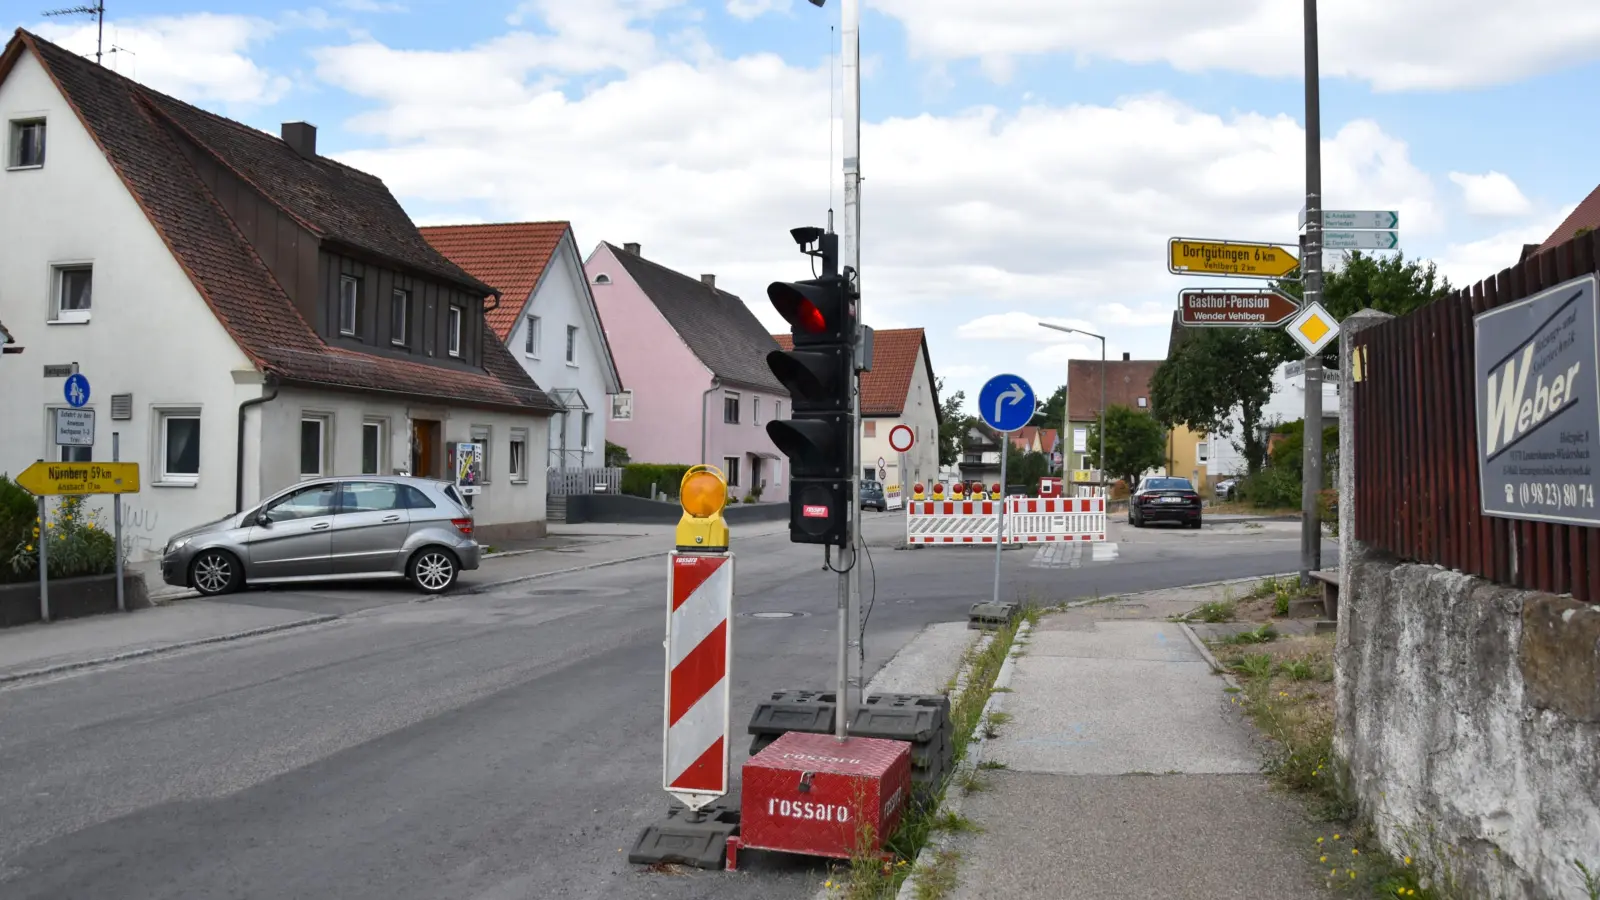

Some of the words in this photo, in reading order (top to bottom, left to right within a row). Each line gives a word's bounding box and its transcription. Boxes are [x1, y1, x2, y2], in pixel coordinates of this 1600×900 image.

[1183, 245, 1249, 263] Dorfgütingen
[1254, 248, 1260, 261] 6
[1262, 251, 1275, 262] km
[1204, 261, 1238, 273] Vehlberg
[1241, 263, 1246, 271] 2
[1189, 295, 1270, 309] Gasthof-Pension
[1194, 312, 1226, 320] Wender
[1228, 312, 1265, 321] Vehlberg
[1486, 341, 1580, 457] Weber
[48, 466, 88, 482] Nürnberg
[91, 466, 100, 479] 59
[101, 467, 112, 479] km
[58, 482, 84, 491] Ansbach
[88, 482, 93, 490] 17
[1531, 482, 1544, 504] 98
[1545, 483, 1561, 510] 23)
[1563, 483, 1577, 506] 80
[1579, 484, 1594, 508] 74
[783, 752, 861, 765] rossaro
[768, 798, 849, 823] rossaro
